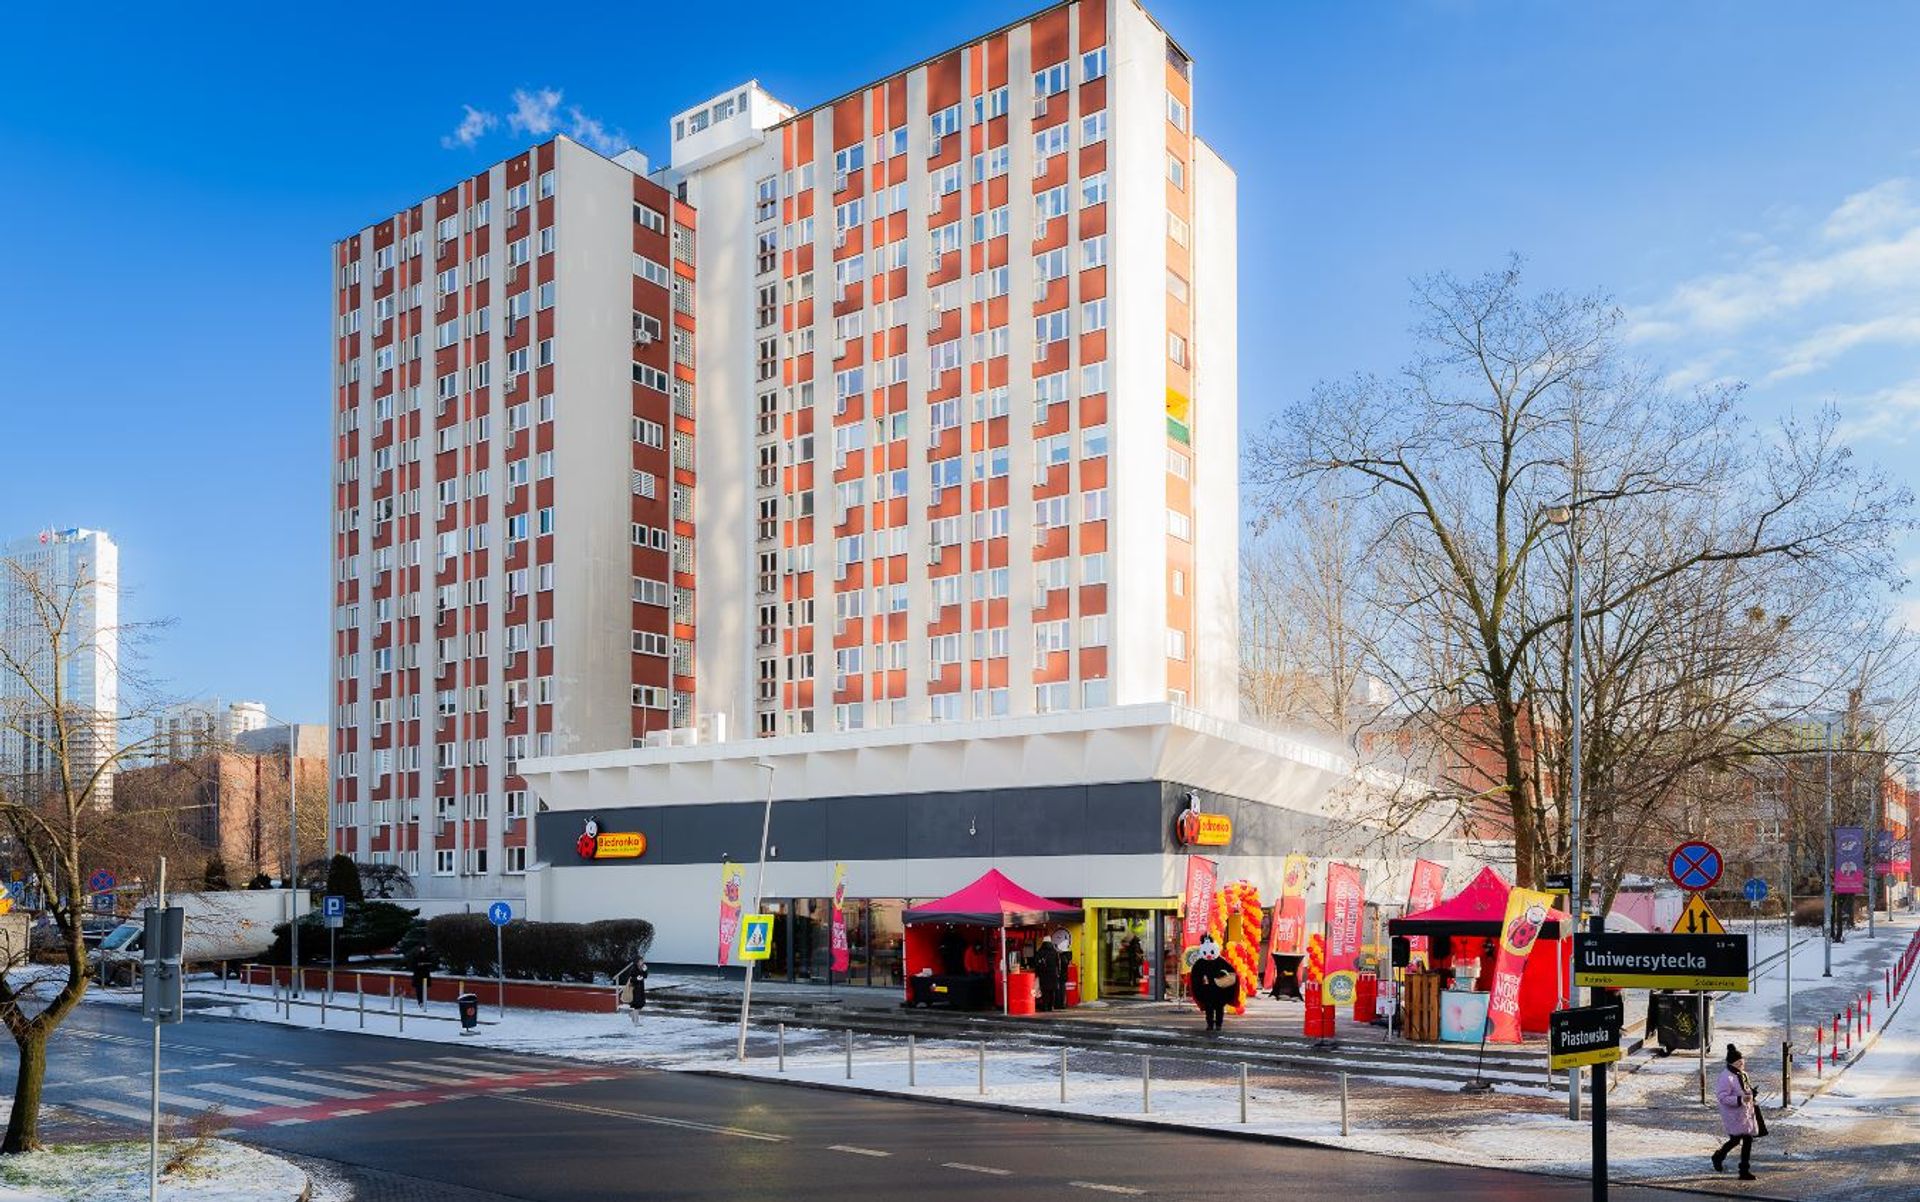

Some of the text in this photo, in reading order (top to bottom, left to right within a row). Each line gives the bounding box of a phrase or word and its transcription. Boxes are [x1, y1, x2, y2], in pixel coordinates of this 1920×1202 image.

[598, 837, 640, 847] Biedronka
[1585, 951, 1707, 971] Uniwersytecka
[1561, 1027, 1609, 1047] Piastowska
